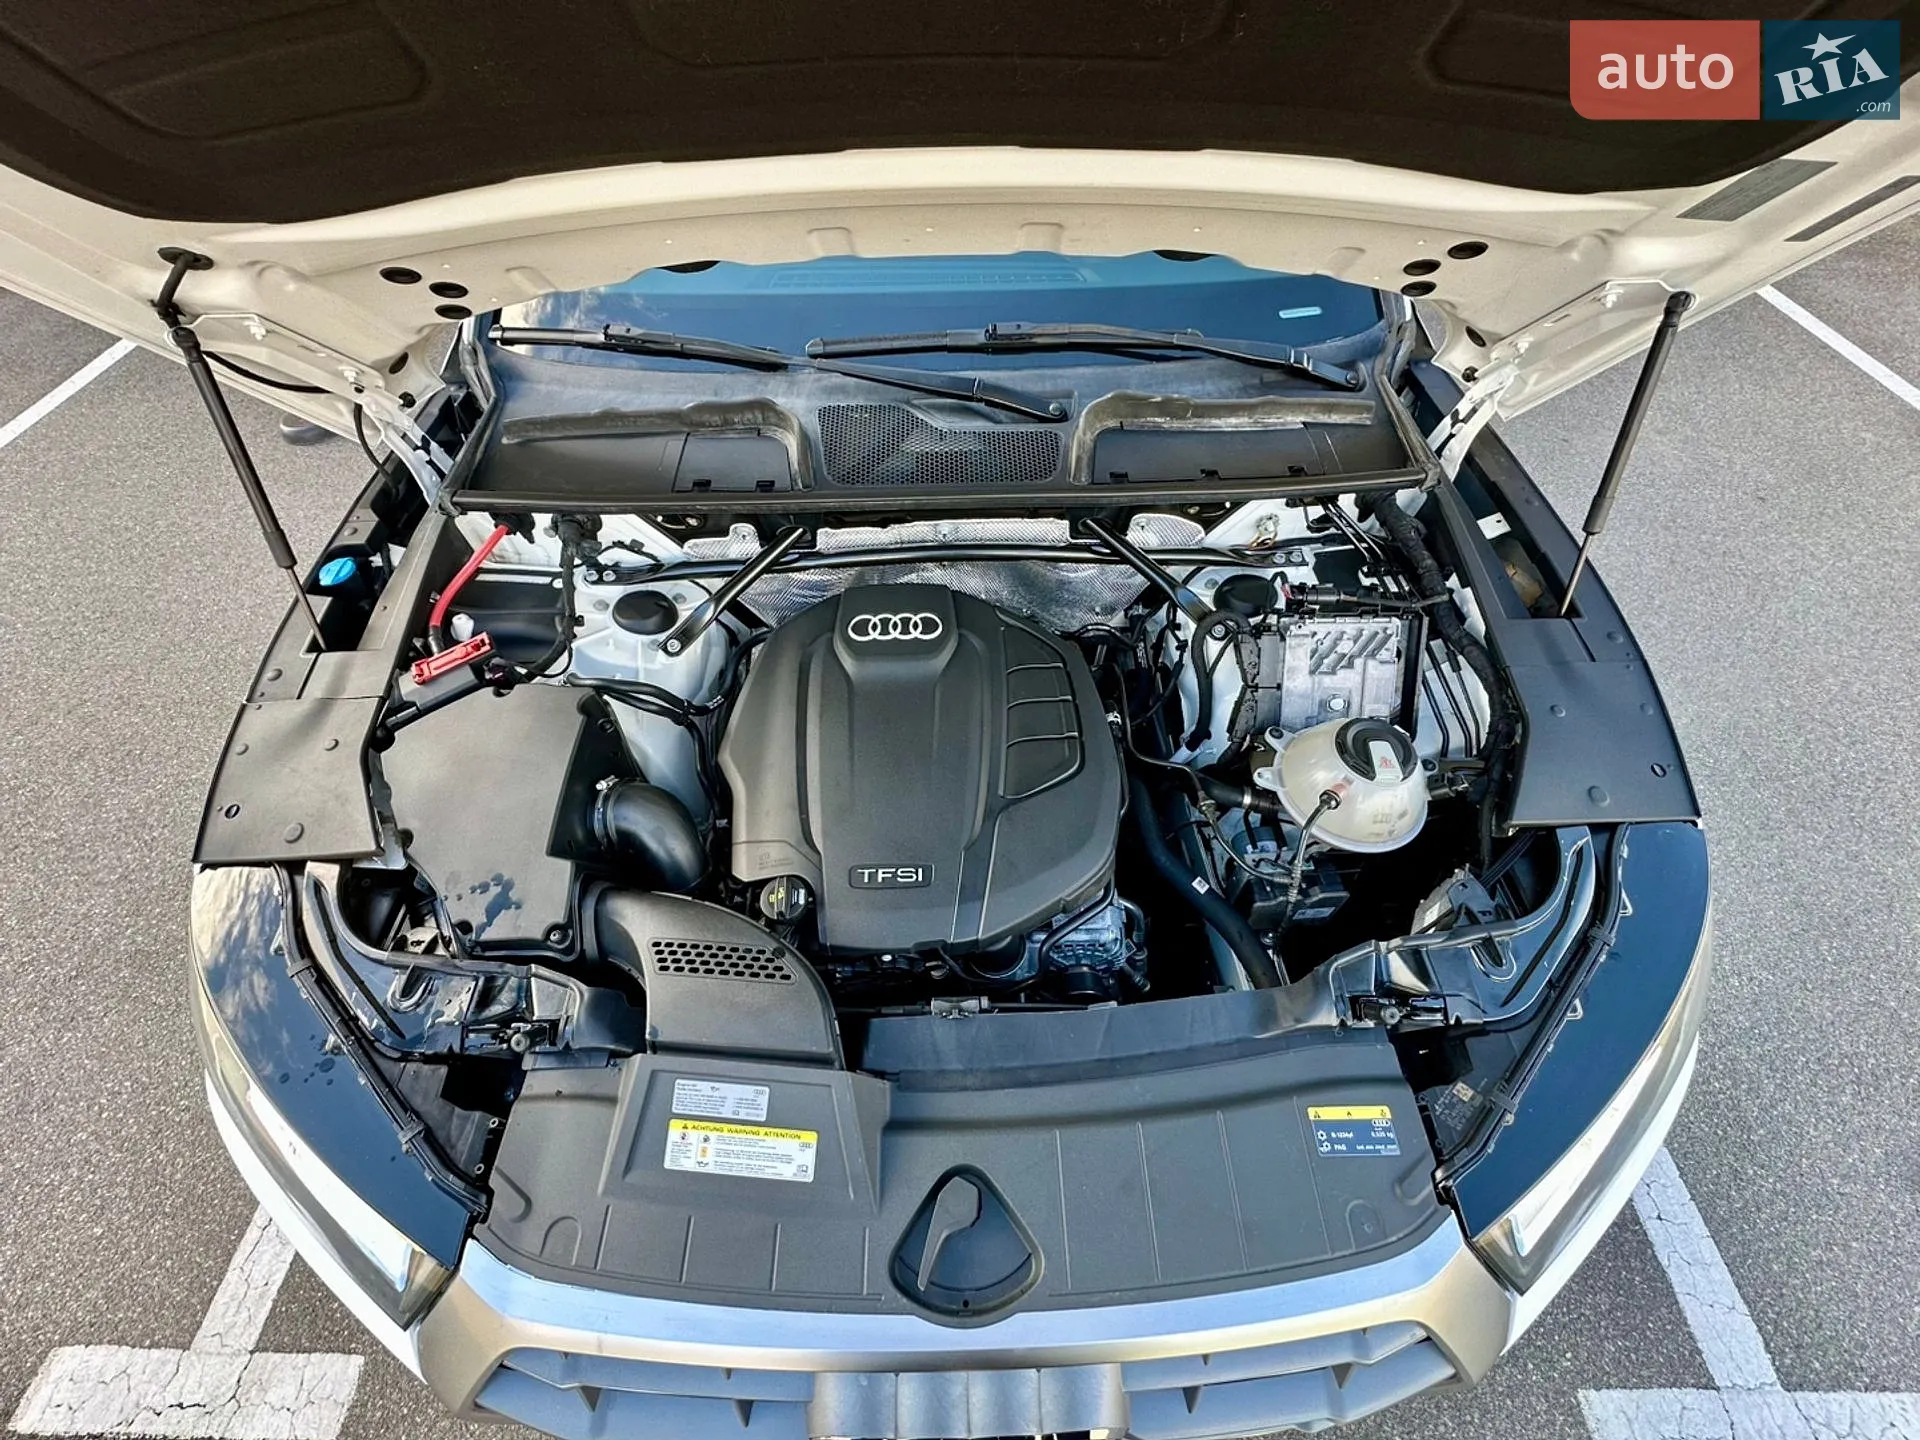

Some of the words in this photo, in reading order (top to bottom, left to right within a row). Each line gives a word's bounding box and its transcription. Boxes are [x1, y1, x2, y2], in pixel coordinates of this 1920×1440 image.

[857, 867, 923, 883] TFSI
[690, 1123, 725, 1133] ACHTUNG
[727, 1127, 761, 1137] WARNING
[763, 1130, 802, 1140] ATTENTION
